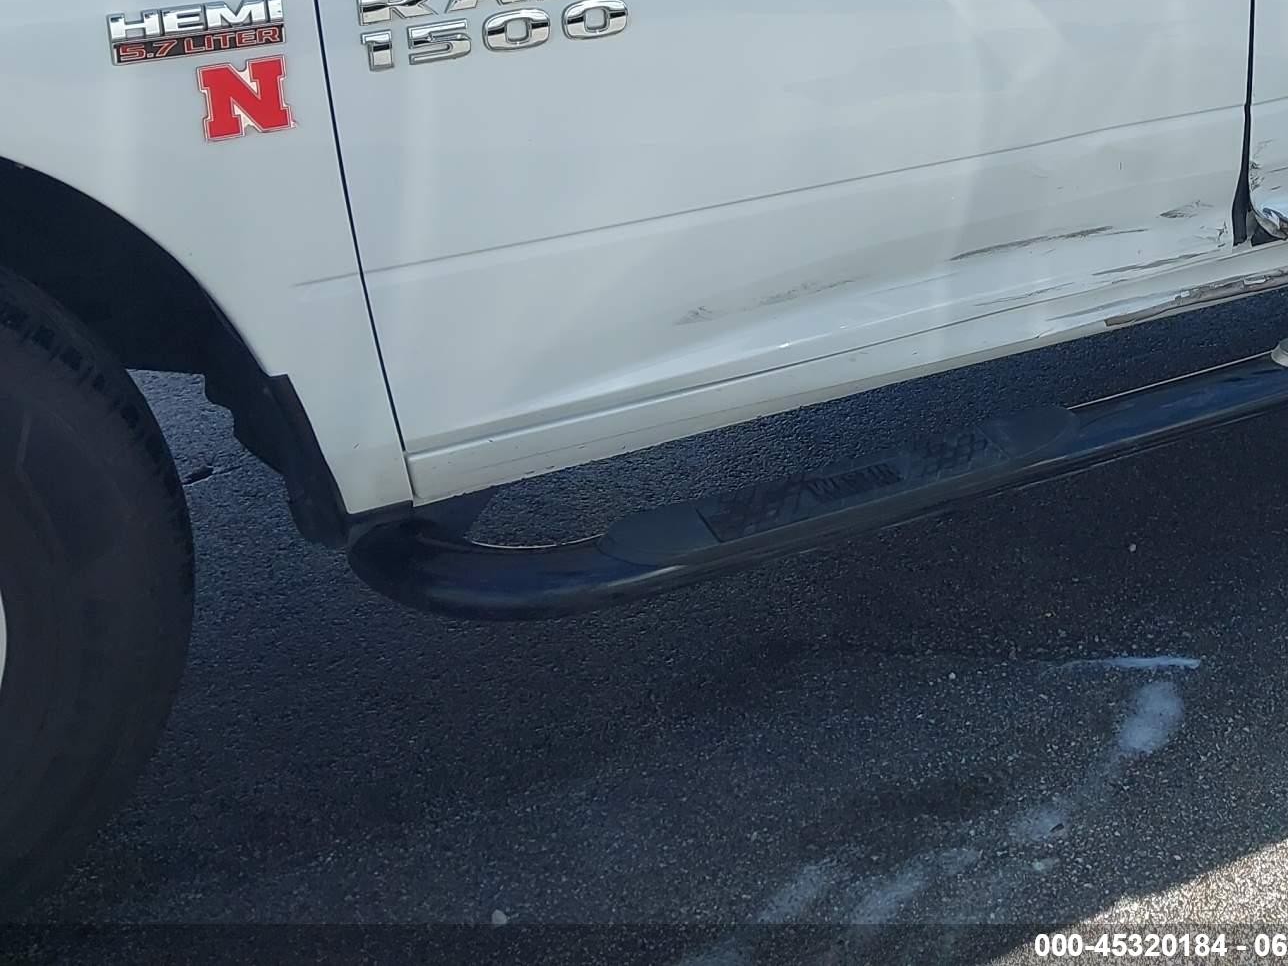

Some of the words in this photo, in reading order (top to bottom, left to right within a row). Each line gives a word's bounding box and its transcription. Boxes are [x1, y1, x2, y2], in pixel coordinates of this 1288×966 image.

[118, 38, 178, 62] 5.7
[183, 27, 282, 54] LITER
[196, 55, 297, 142] N
